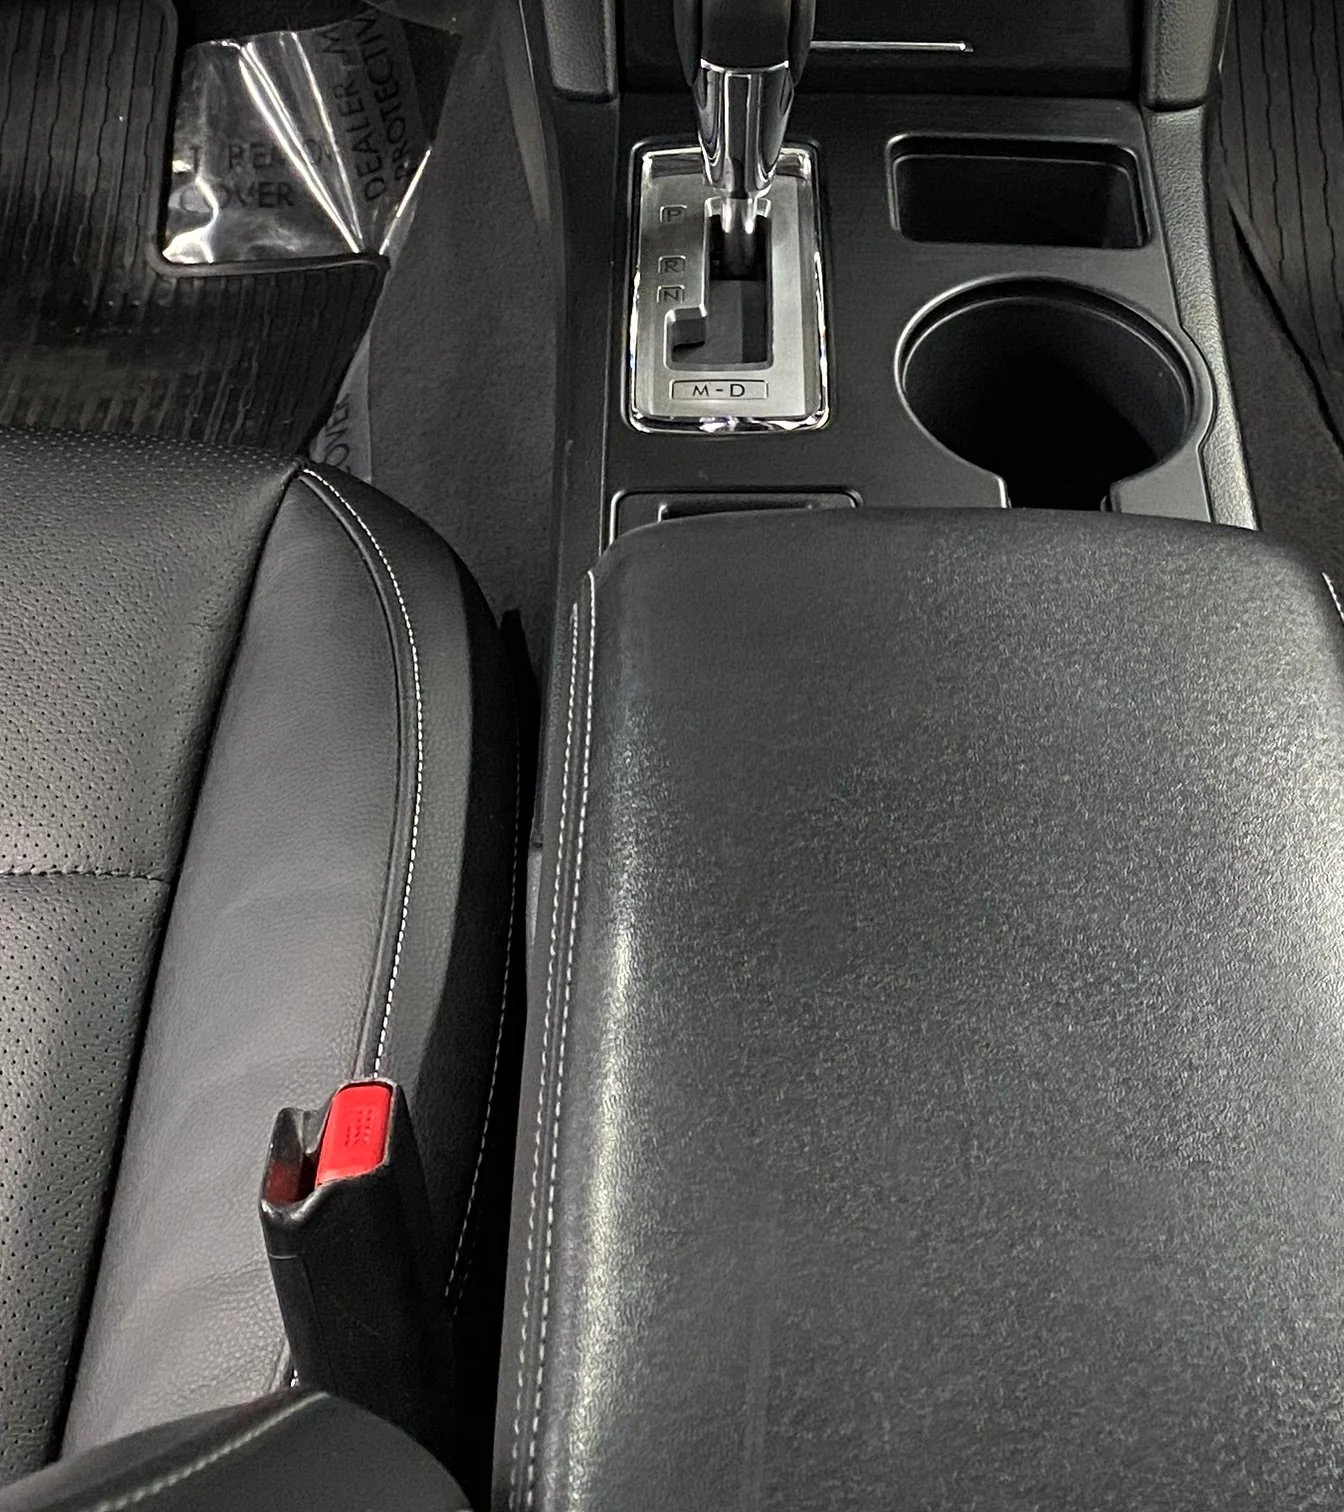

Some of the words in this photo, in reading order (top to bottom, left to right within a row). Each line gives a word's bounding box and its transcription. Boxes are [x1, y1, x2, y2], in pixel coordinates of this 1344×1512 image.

[355, 14, 411, 183] PROTECTIV
[667, 209, 682, 222] P
[666, 259, 679, 273] R
[664, 289, 679, 301] N
